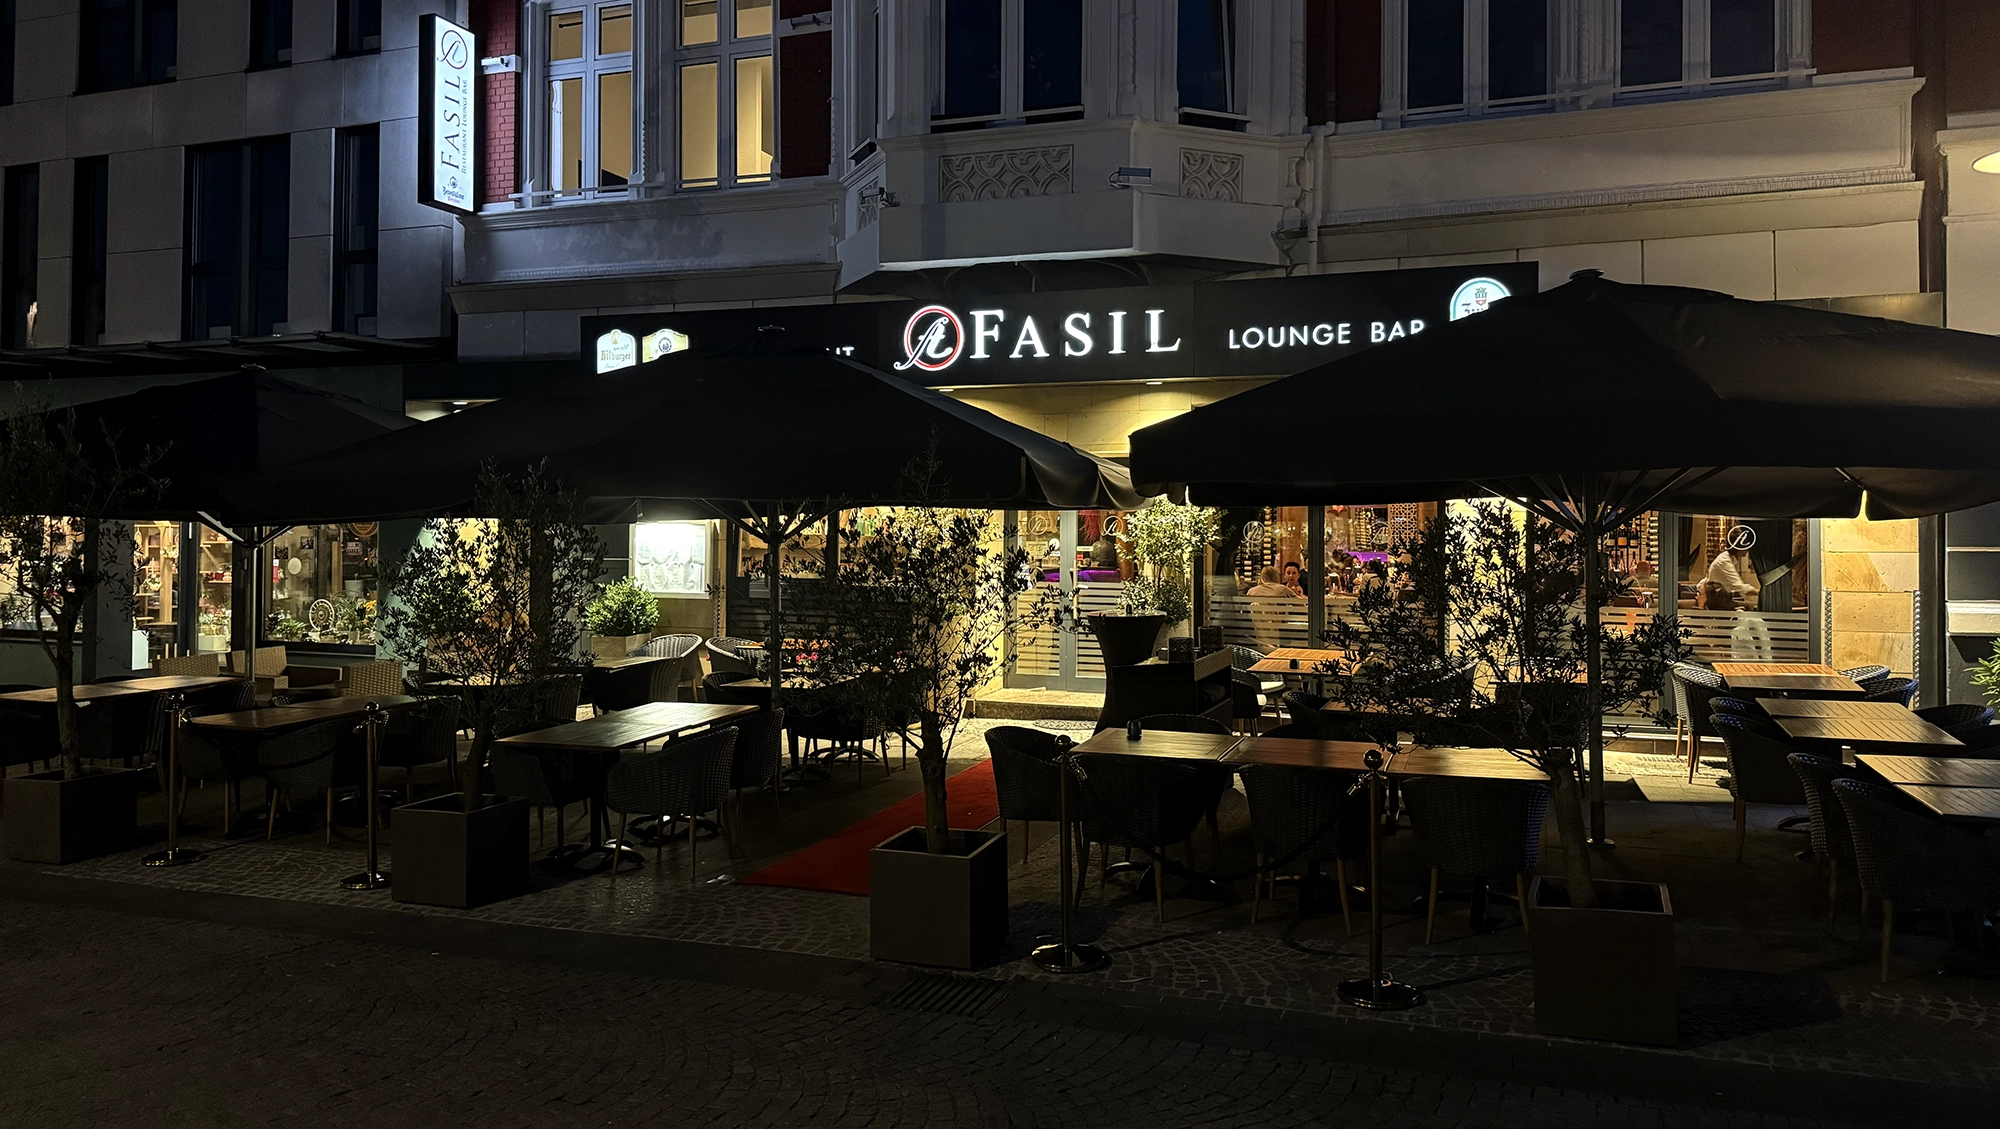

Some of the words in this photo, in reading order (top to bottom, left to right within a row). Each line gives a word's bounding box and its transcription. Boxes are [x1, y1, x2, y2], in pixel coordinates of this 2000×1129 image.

[441, 75, 461, 171] FASIL
[969, 309, 1181, 359] FASIL
[1228, 322, 1351, 349] LOUNGE
